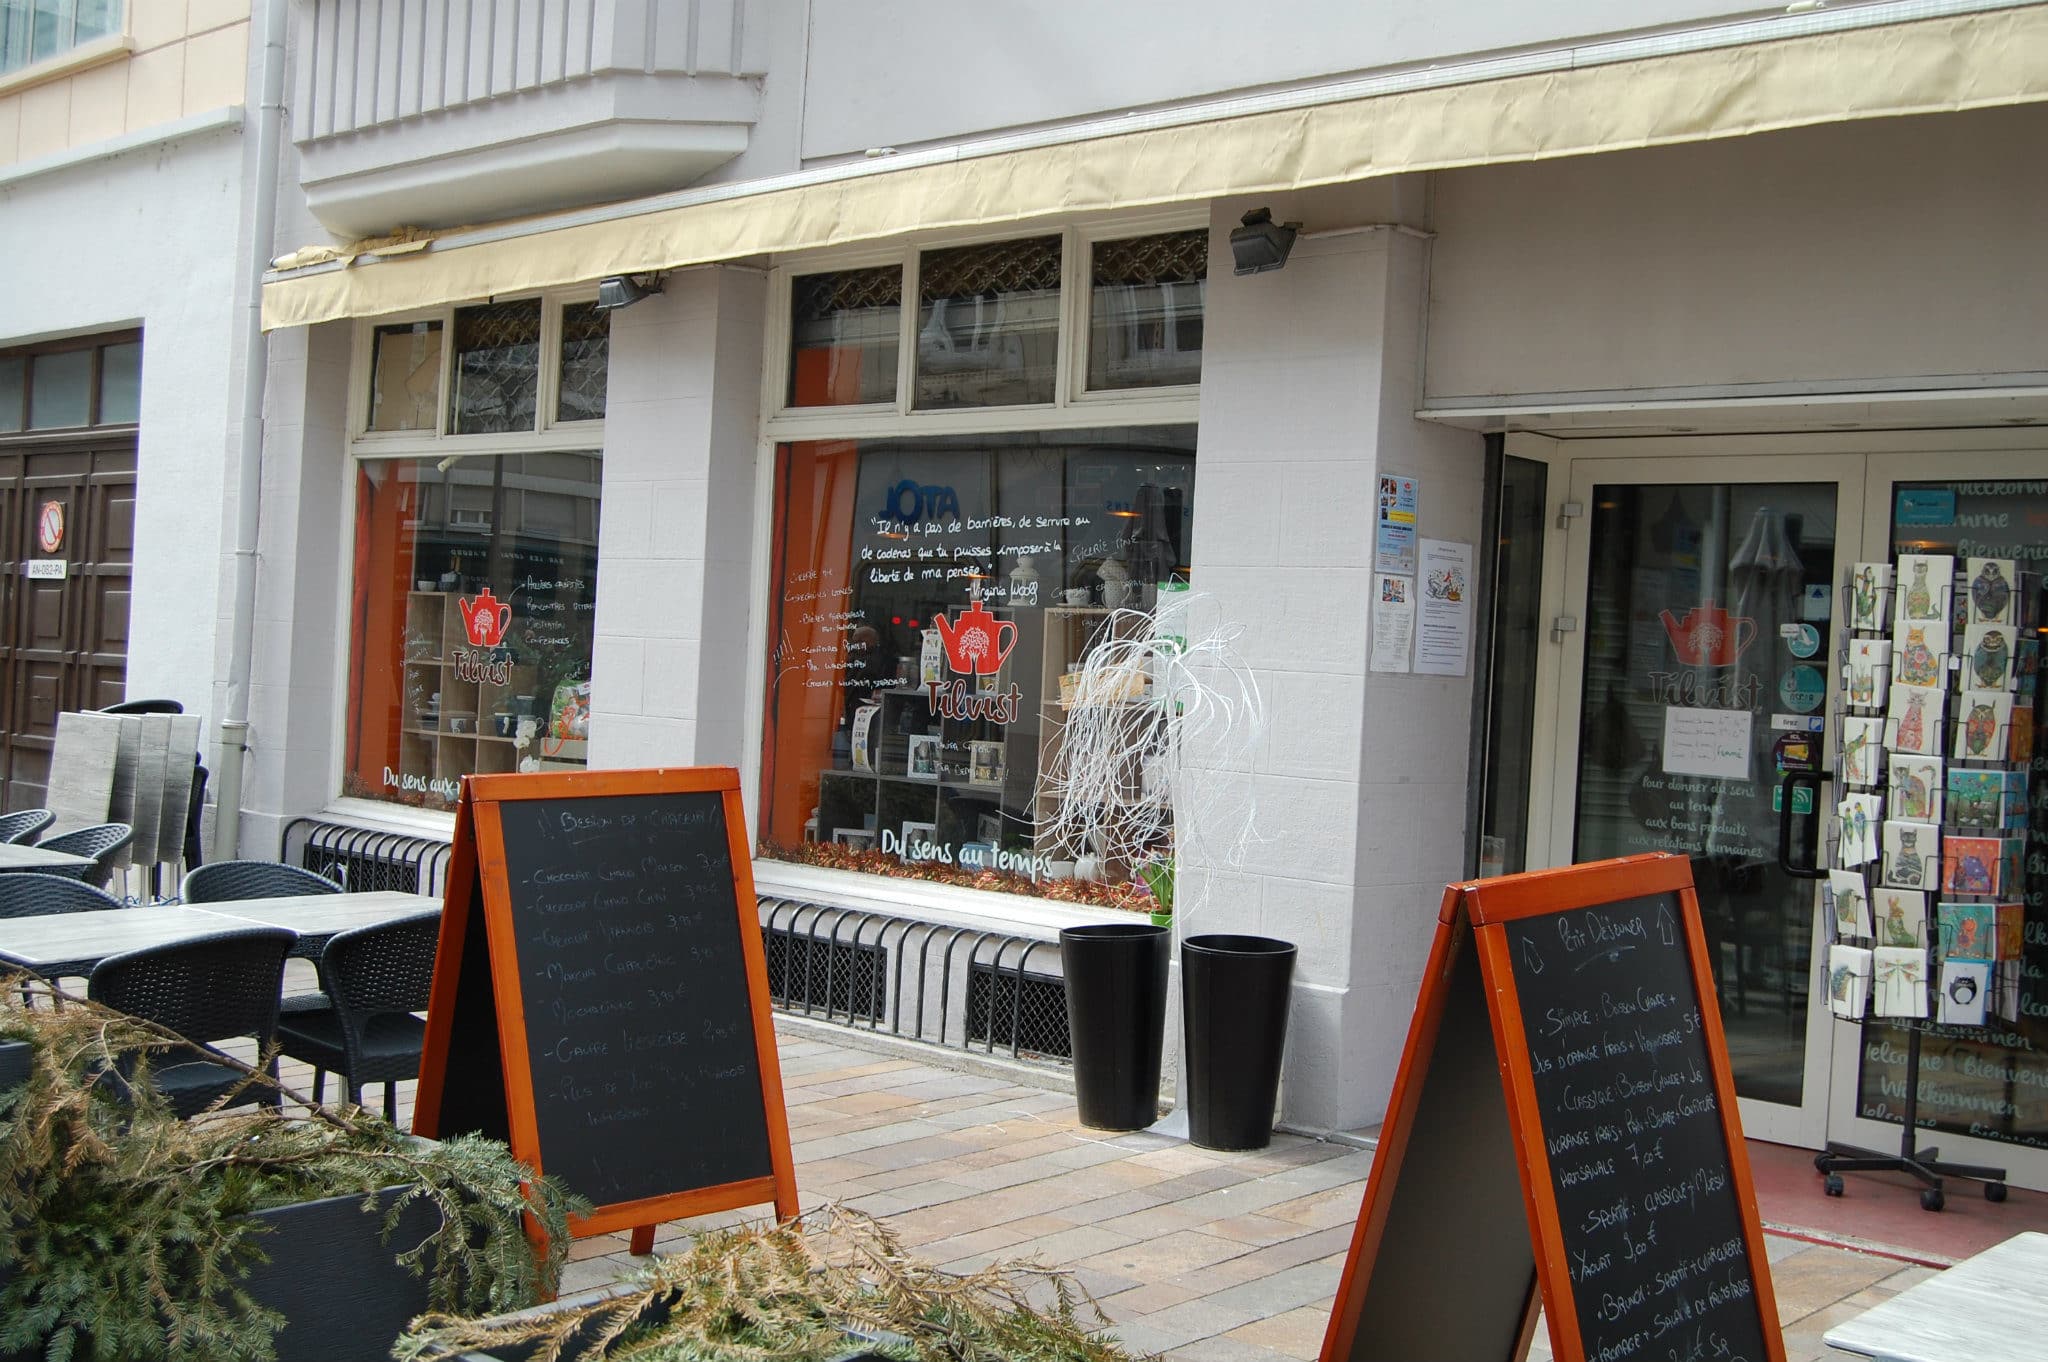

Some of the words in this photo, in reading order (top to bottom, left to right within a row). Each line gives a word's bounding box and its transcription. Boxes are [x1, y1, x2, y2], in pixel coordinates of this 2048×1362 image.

[913, 524, 921, 533] a
[925, 523, 941, 536] pas
[948, 519, 961, 534] de
[1018, 516, 1032, 529] de
[861, 549, 872, 560] de
[877, 548, 911, 559] cadenas
[918, 549, 933, 561] que
[936, 546, 948, 558] tu
[954, 547, 991, 562] puisses
[996, 544, 1039, 557] imposer
[869, 567, 901, 583] liberté
[904, 567, 914, 581] de
[921, 569, 942, 579] ma
[1010, 581, 1038, 605] Woolf
[452, 650, 514, 686] Tilvist
[926, 678, 1023, 725] Tilvist
[383, 766, 400, 787] Du
[401, 772, 427, 792] sens
[1642, 776, 1664, 789] Pour
[1668, 777, 1707, 793] donner
[1711, 781, 1727, 794] du
[1730, 785, 1756, 798] sens
[1669, 801, 1685, 810] au
[1645, 818, 1668, 829] aux
[1670, 816, 1697, 832] bons
[1700, 821, 1748, 837] produits
[882, 828, 907, 859] Du
[911, 841, 953, 865] sens
[958, 850, 983, 867] au
[991, 841, 1053, 884] temps
[1653, 835, 1702, 852] relations
[1706, 840, 1764, 858] humaines
